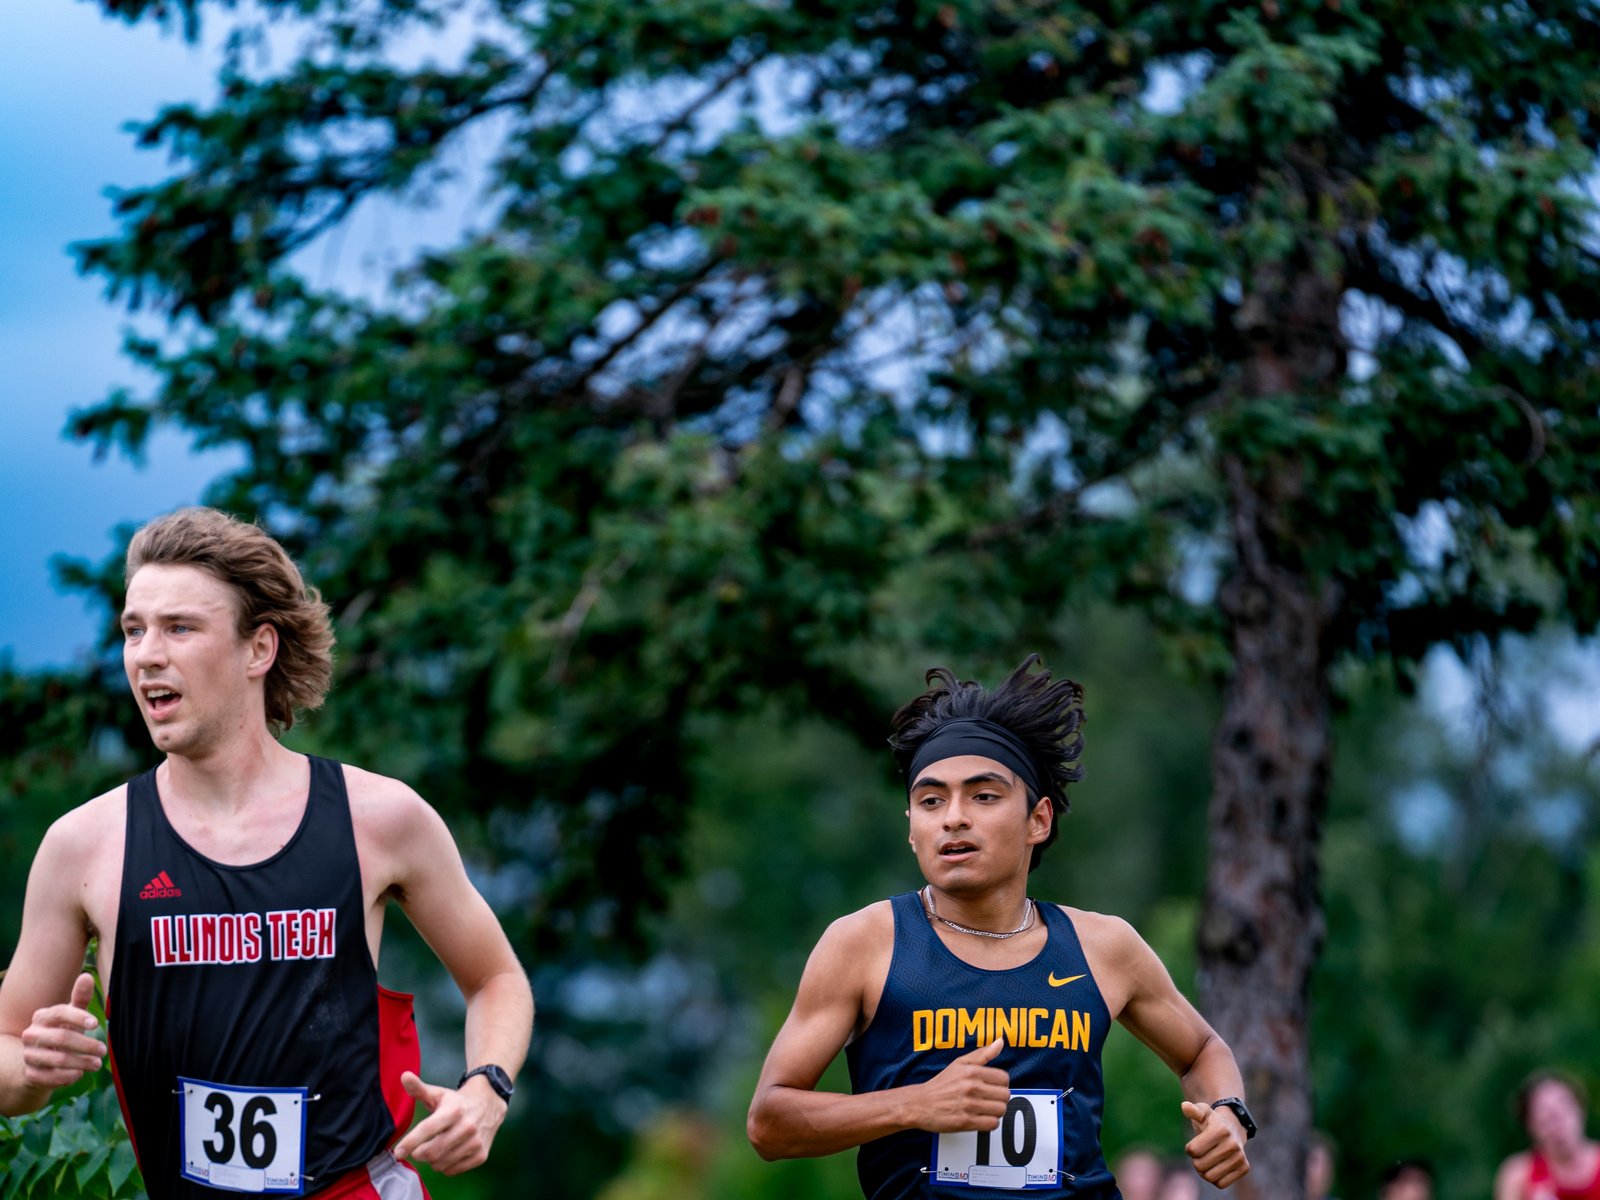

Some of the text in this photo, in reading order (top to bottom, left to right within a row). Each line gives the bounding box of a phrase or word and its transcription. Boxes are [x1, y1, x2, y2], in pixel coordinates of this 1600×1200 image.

[140, 888, 182, 899] adidas
[151, 908, 336, 966] ILLINOIS TECH
[913, 1008, 1090, 1052] DOMINICAN
[202, 1091, 277, 1169] 36
